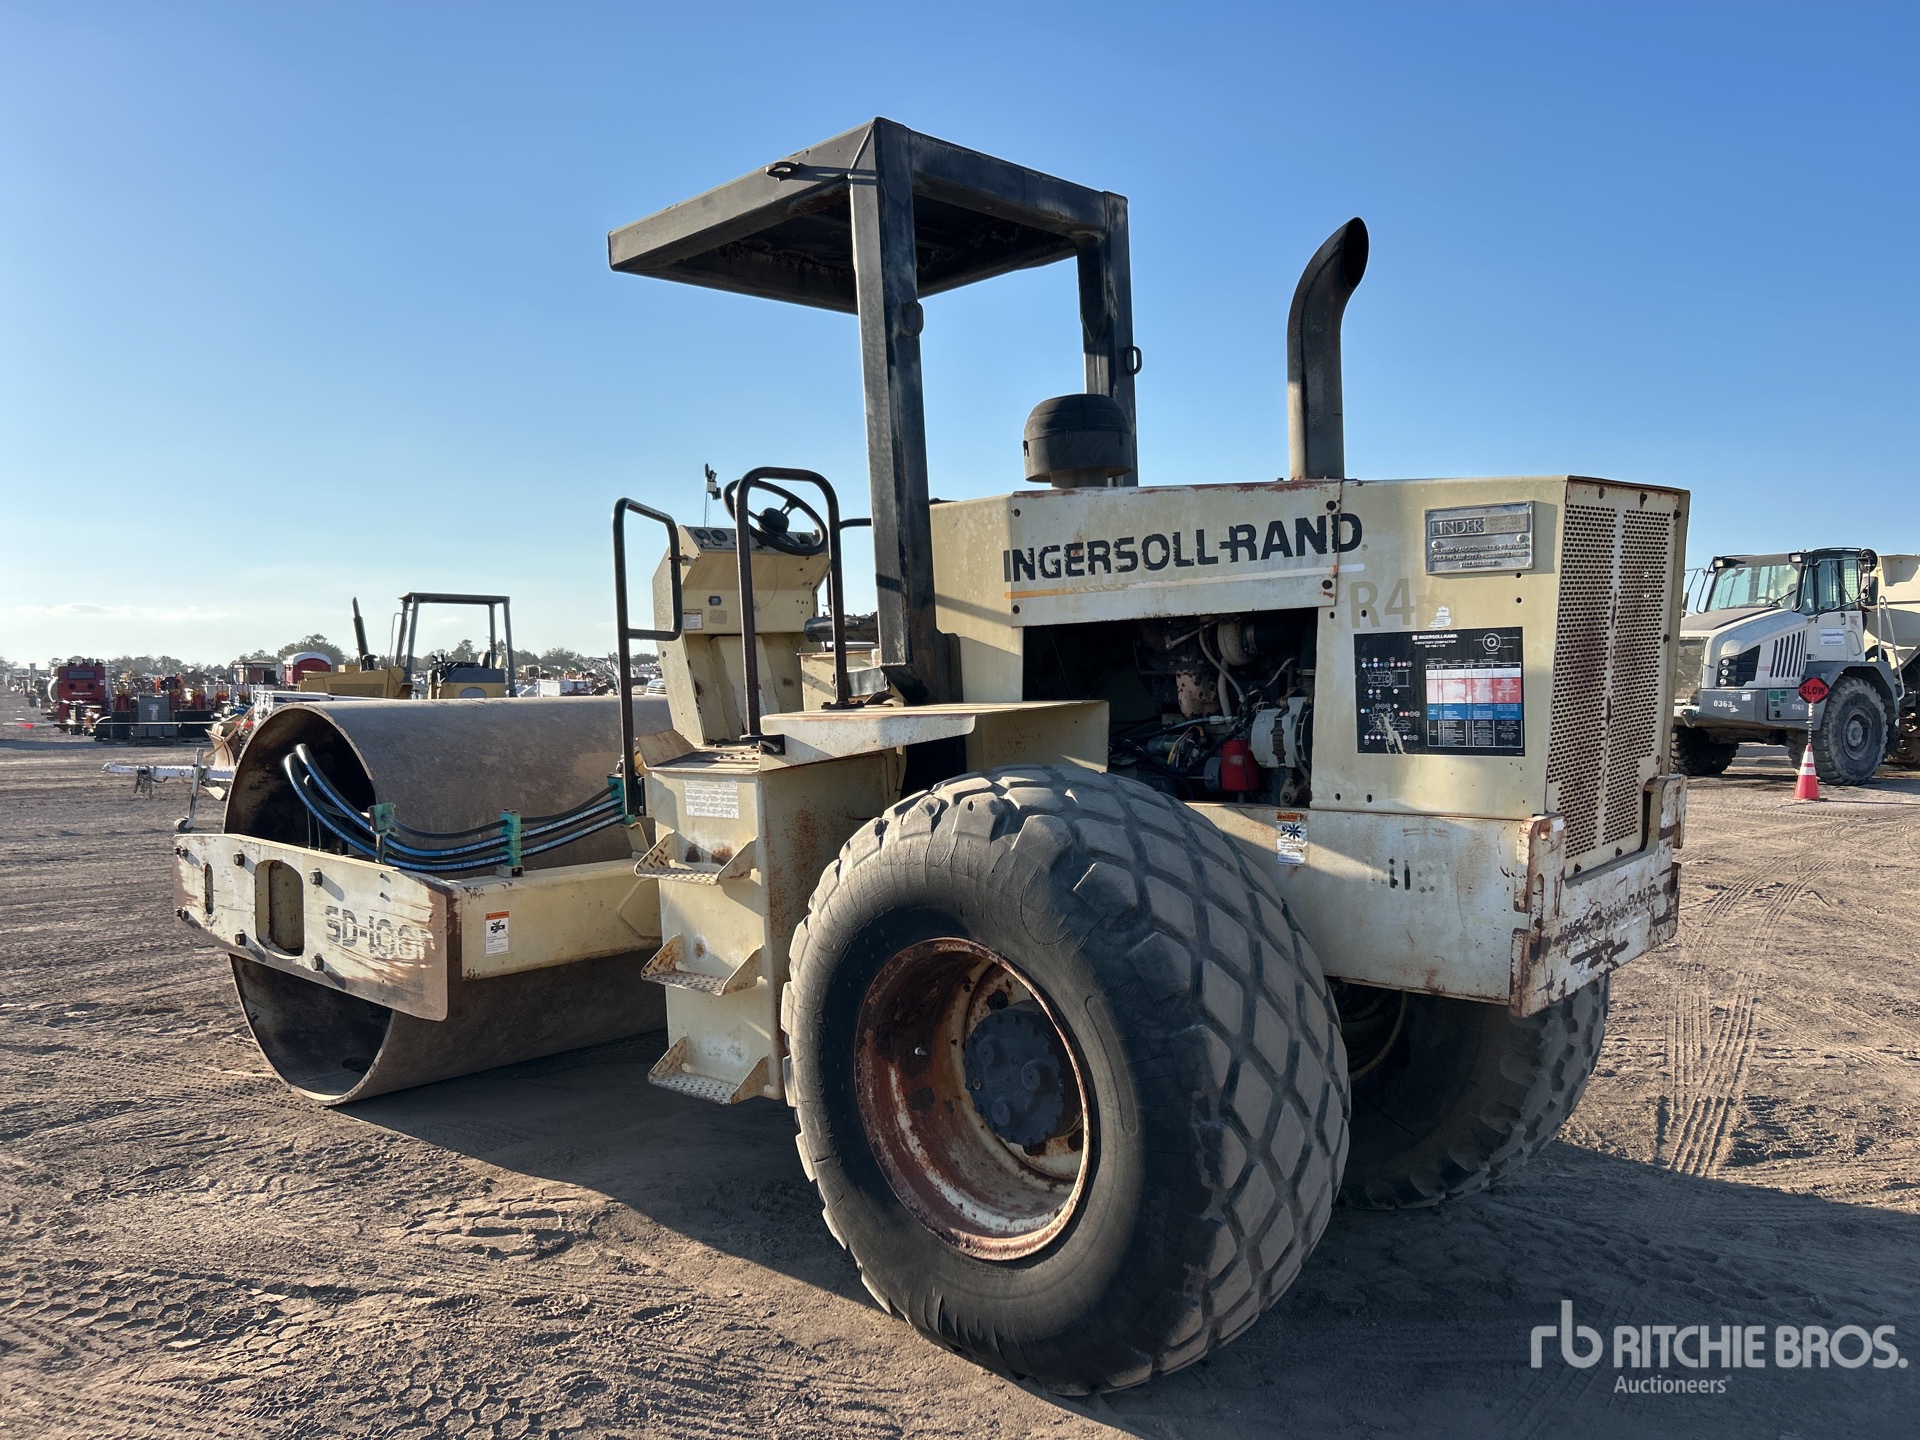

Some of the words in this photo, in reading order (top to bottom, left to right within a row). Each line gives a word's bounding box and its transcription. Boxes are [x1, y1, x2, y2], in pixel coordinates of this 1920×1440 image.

[1431, 519, 1483, 535] LINDER
[1004, 513, 1363, 583] INGERSOLL-RAND
[1801, 685, 1826, 696] SLOW
[1713, 700, 1733, 708] 0363
